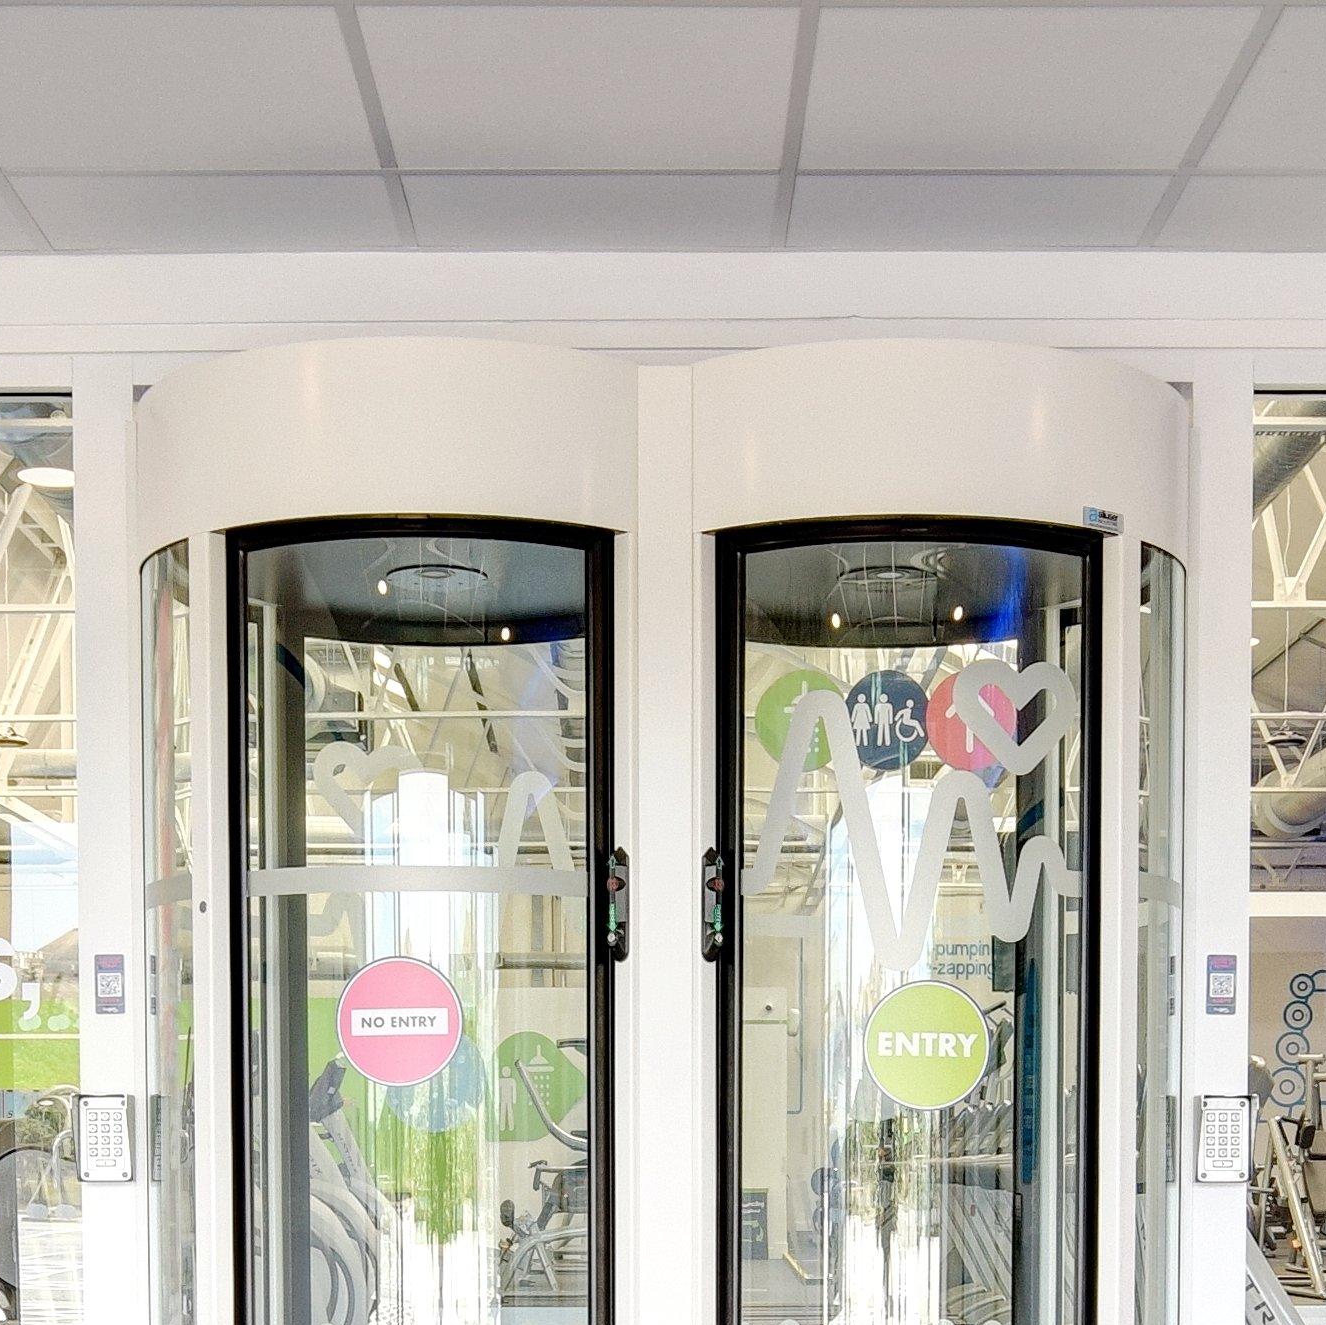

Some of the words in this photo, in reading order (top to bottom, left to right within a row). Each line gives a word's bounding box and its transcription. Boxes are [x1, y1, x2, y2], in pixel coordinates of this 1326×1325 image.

[360, 1016, 385, 1029] NO
[390, 1015, 437, 1029] ENTRY
[877, 1031, 978, 1058] ENTRY
